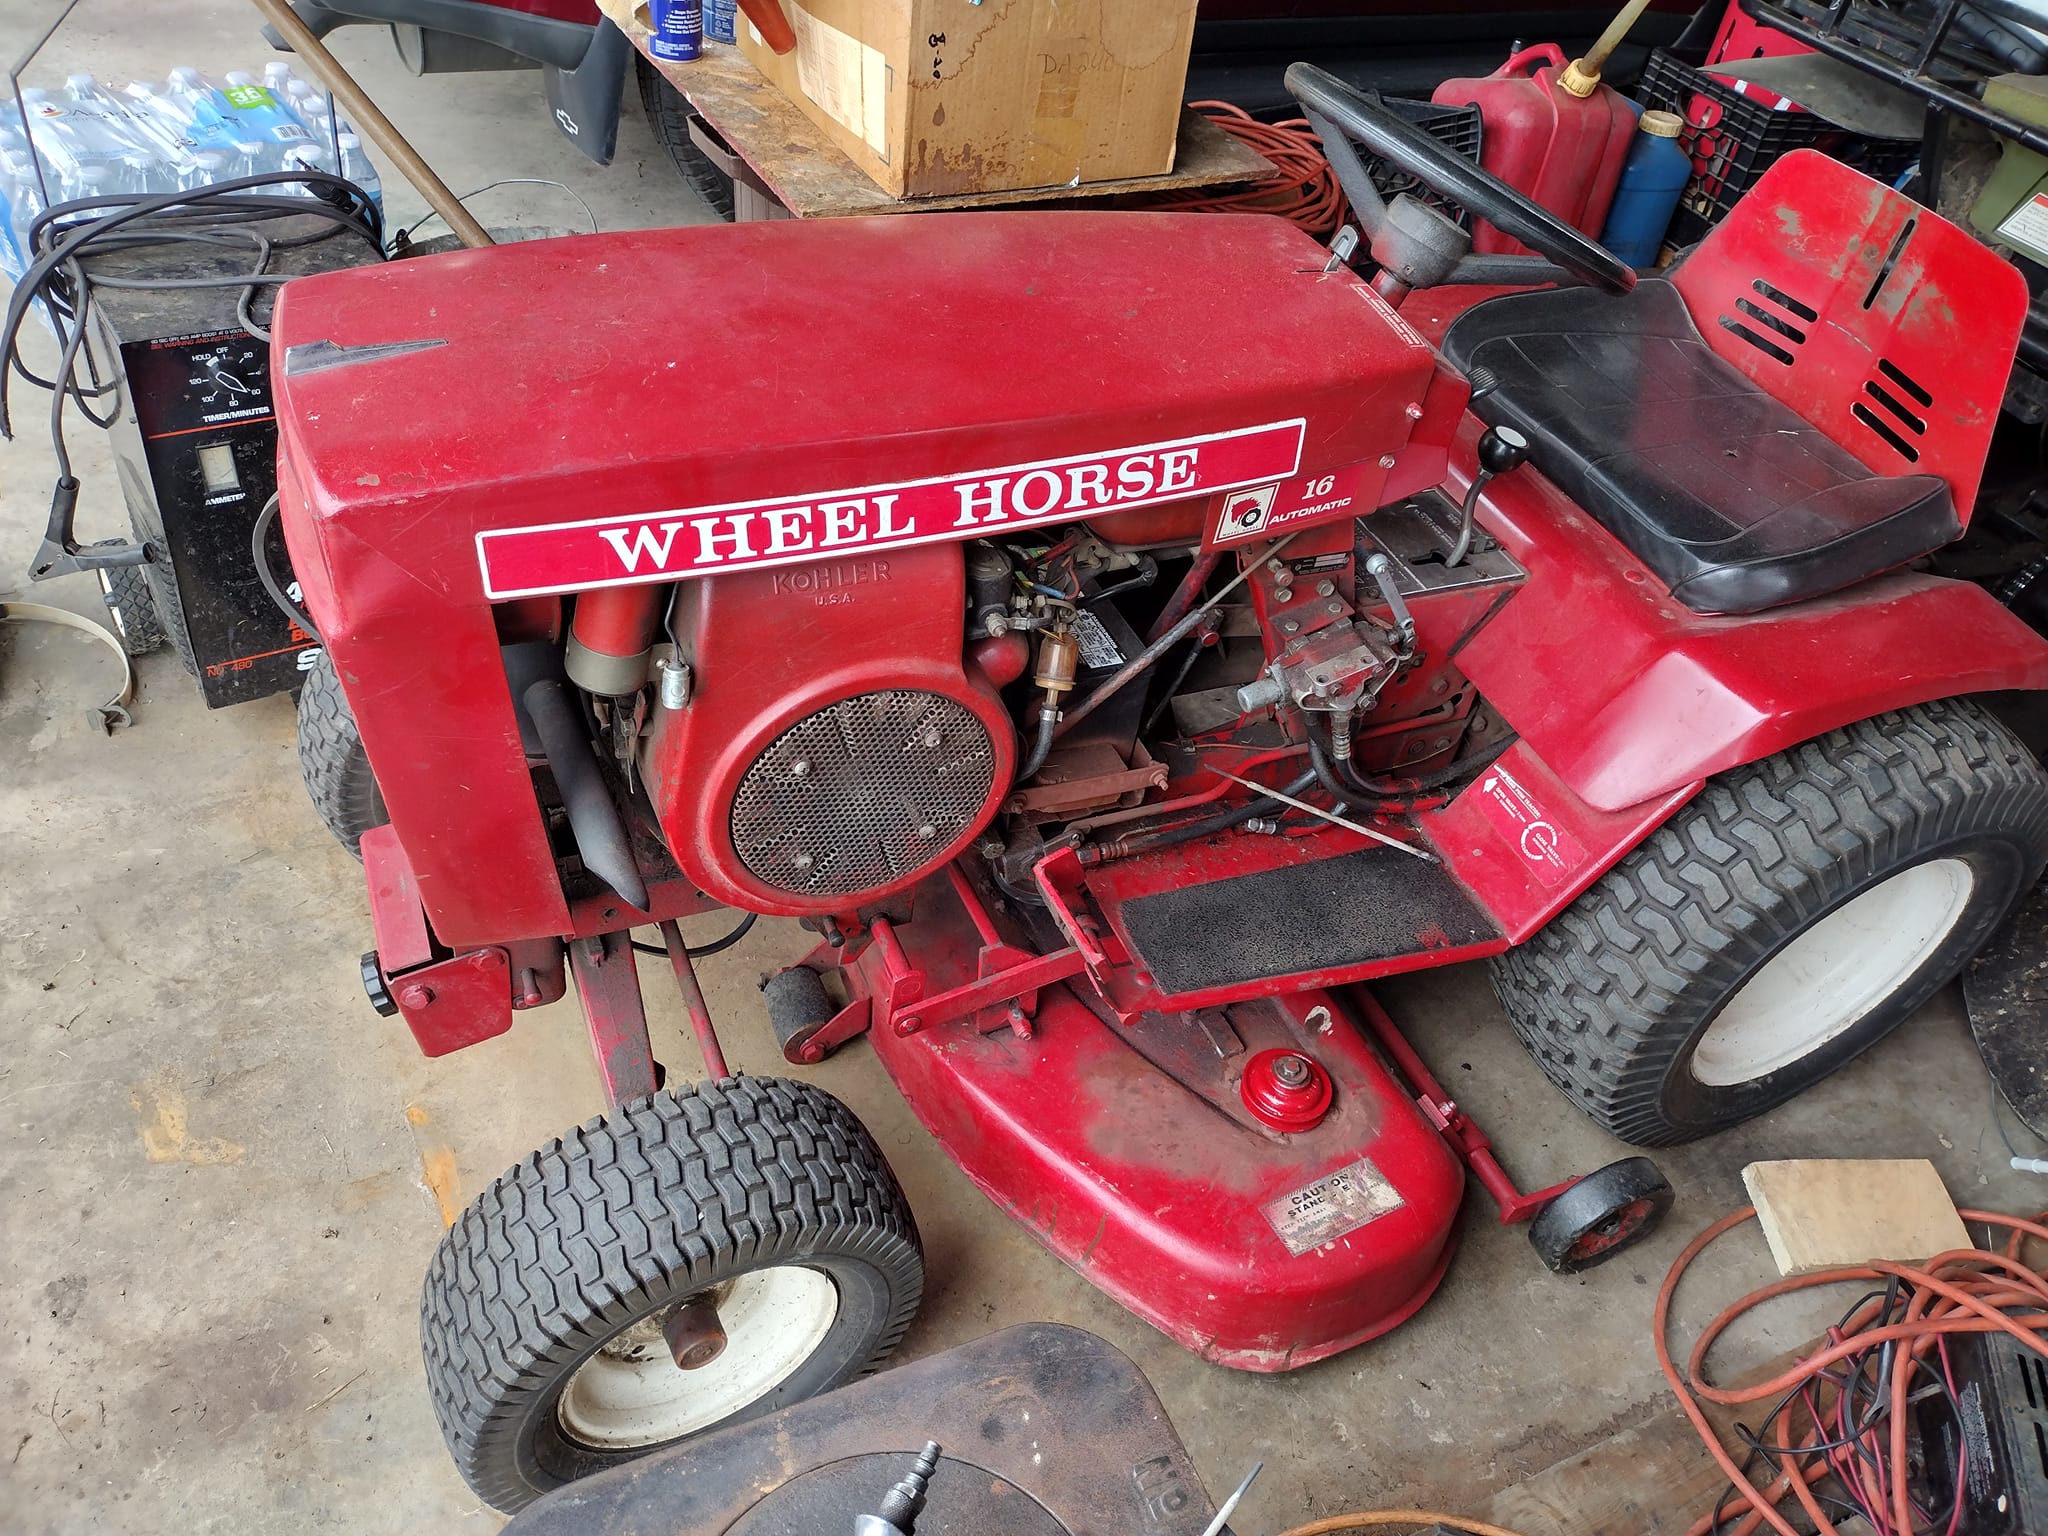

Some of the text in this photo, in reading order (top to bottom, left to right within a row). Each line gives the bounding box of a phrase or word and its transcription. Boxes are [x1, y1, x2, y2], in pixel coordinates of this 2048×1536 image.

[192, 353, 212, 362] HOLD
[216, 346, 229, 354] OFF
[202, 406, 270, 423] TIMER/MINUTES
[1301, 474, 1336, 500] 16
[598, 447, 1200, 573] WHEEL HORSE
[1268, 497, 1352, 525] AUTOMATIC
[772, 560, 892, 595] KOHLER
[230, 660, 253, 671] 480
[1535, 832, 1548, 846] CLOSE
[1292, 1173, 1348, 1206] CAUTON
